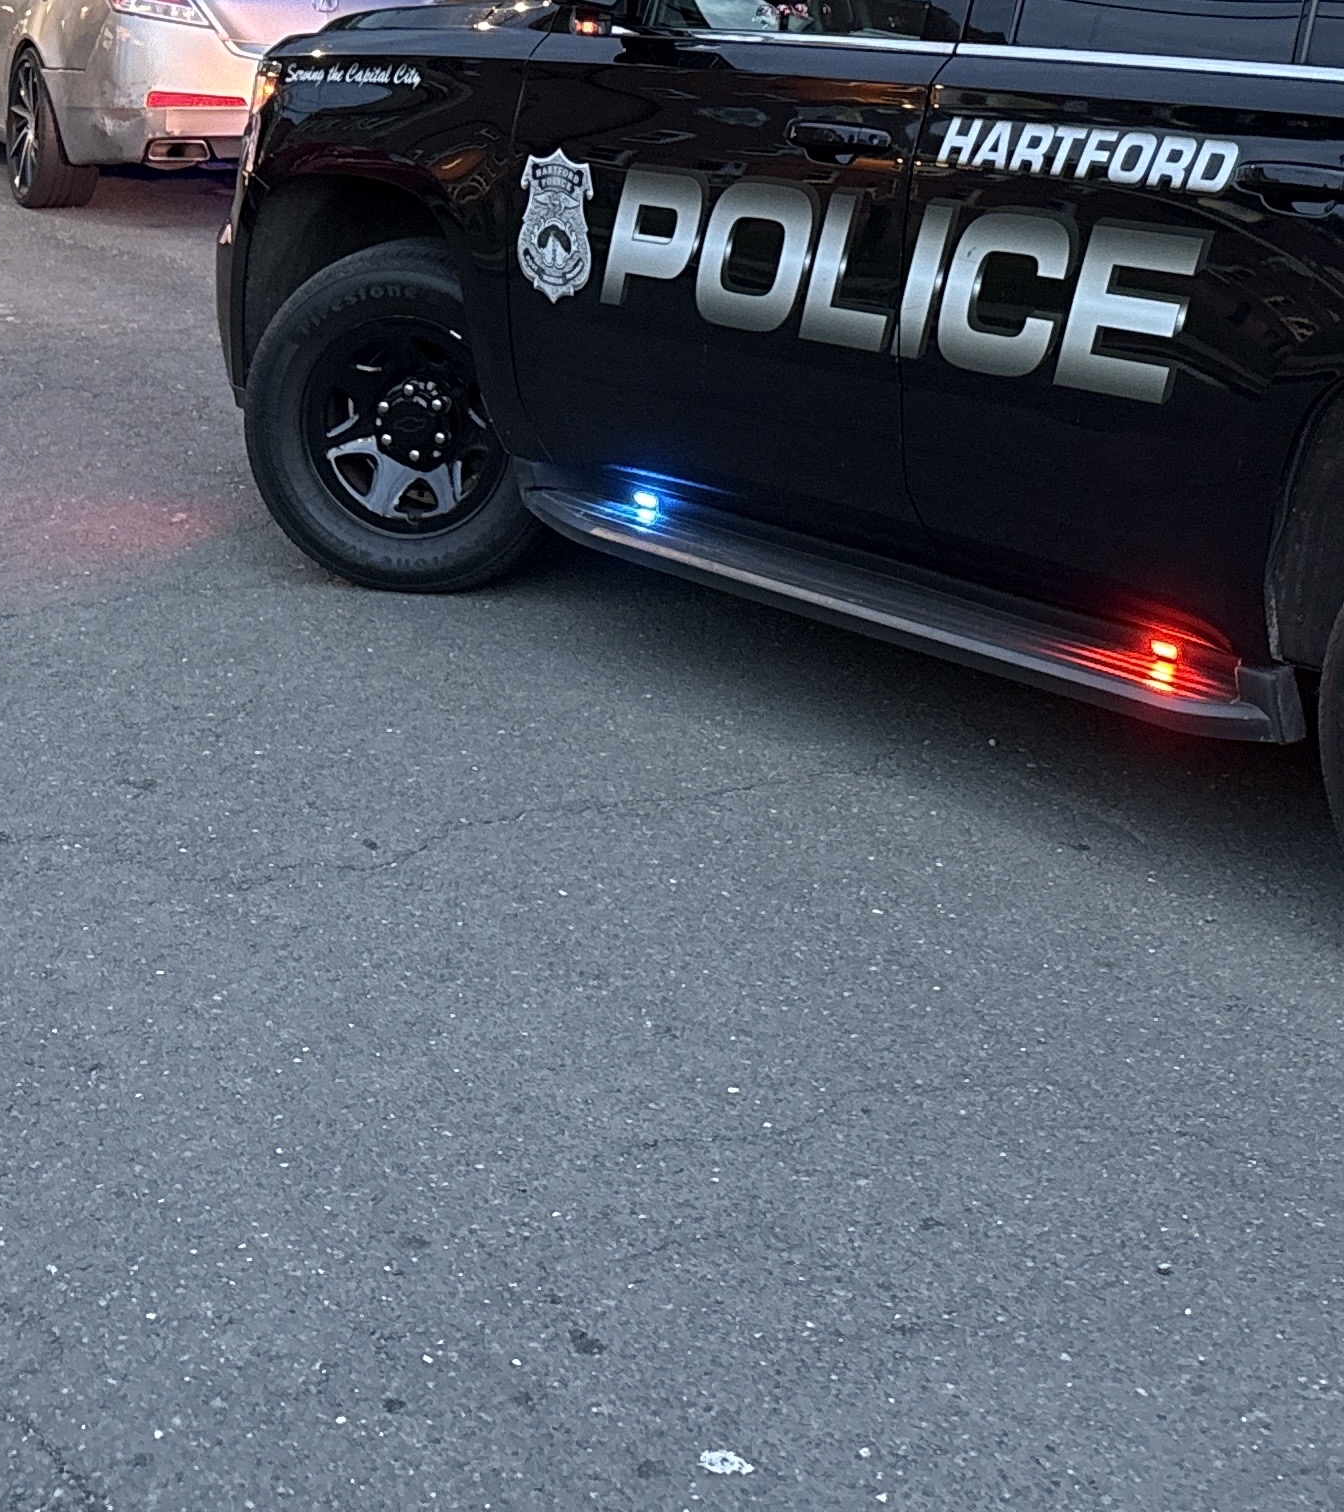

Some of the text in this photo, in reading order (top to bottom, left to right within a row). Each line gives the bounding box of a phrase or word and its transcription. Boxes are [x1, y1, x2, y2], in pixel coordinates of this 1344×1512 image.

[285, 61, 422, 90] Serving the Capital City
[936, 116, 1240, 194] HARTFORD
[536, 165, 580, 185] HARTFORD
[541, 176, 572, 192] POLICE
[600, 164, 1212, 404] POLICE
